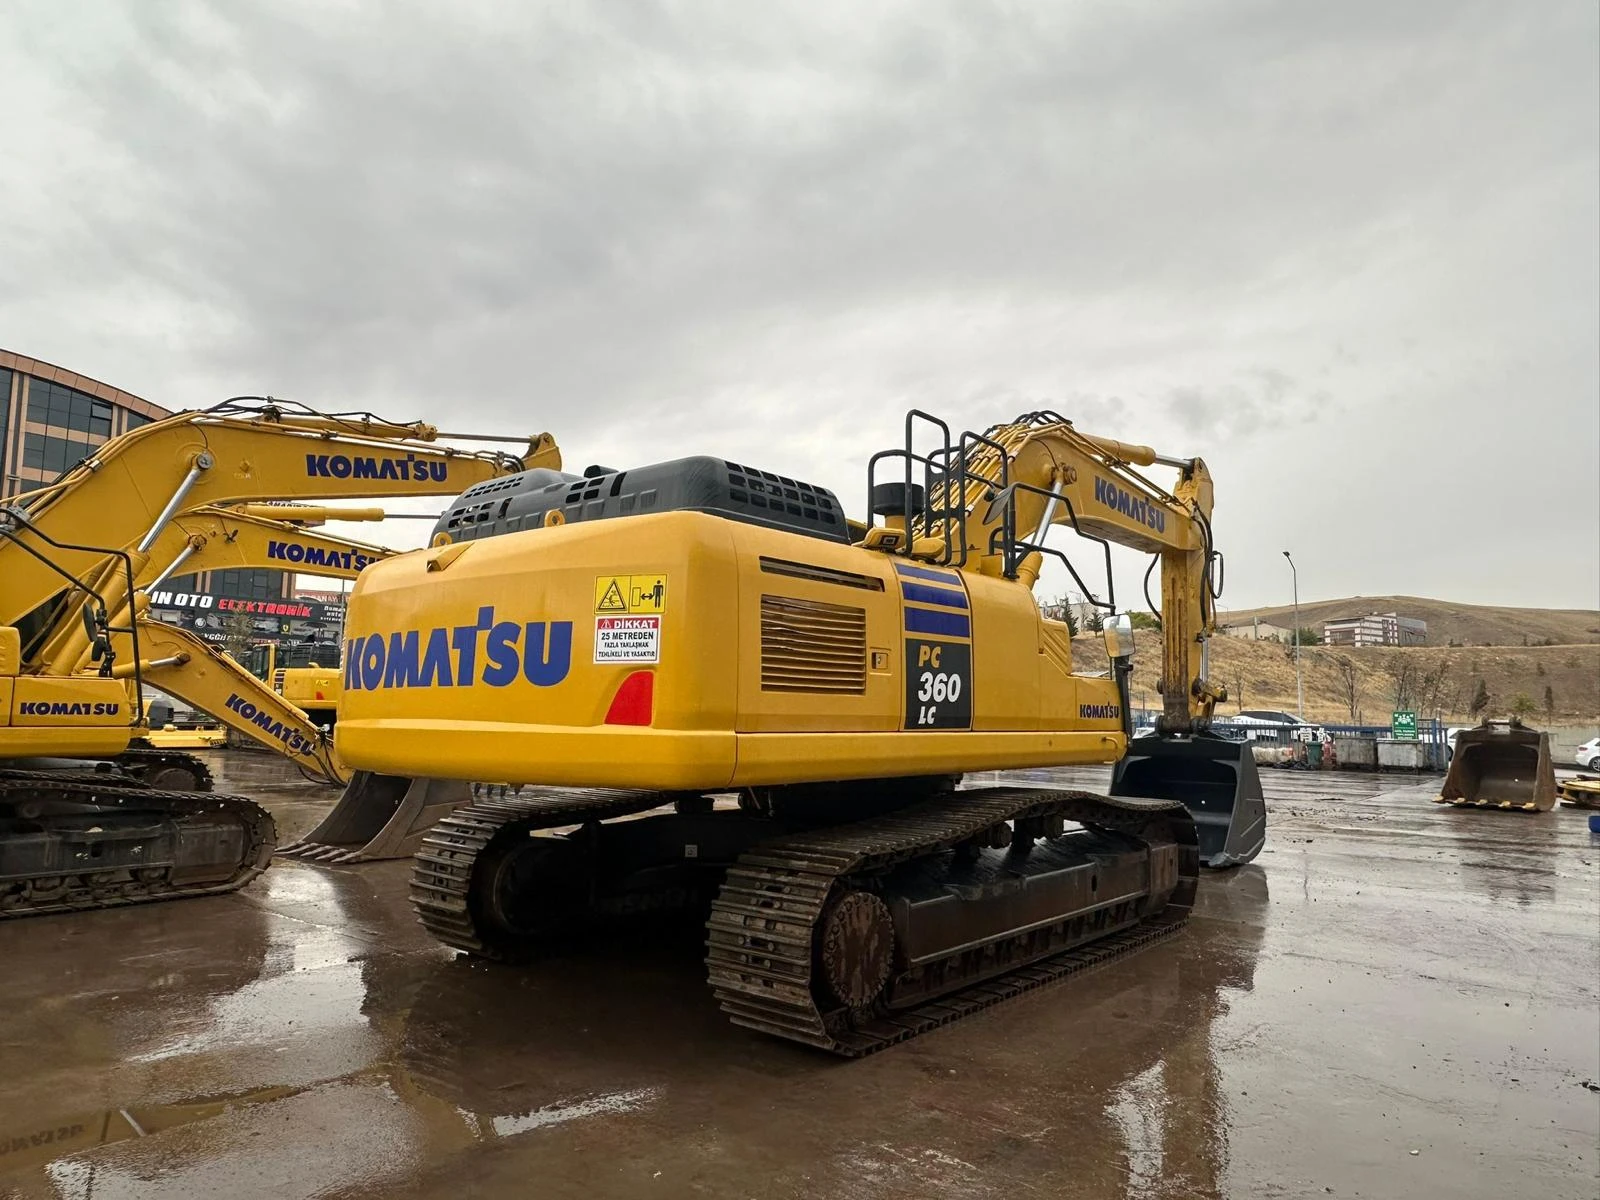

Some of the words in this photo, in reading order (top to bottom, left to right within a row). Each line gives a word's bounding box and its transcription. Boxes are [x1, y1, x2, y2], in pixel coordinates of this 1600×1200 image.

[306, 453, 447, 482] KOMATSU
[1095, 475, 1165, 533] KOMATSU
[267, 540, 382, 571] KOMATS
[151, 591, 172, 605] IN
[174, 593, 213, 608] OTO
[613, 619, 655, 629] DİKKAT
[601, 632, 611, 641] 25
[612, 631, 654, 640] METREDEN
[344, 606, 573, 691] KOMATSU
[918, 645, 941, 667] PC
[917, 672, 961, 703] 360
[20, 702, 119, 716] KOMATSU
[918, 706, 937, 725] LC
[1079, 702, 1120, 719] KOMATSU
